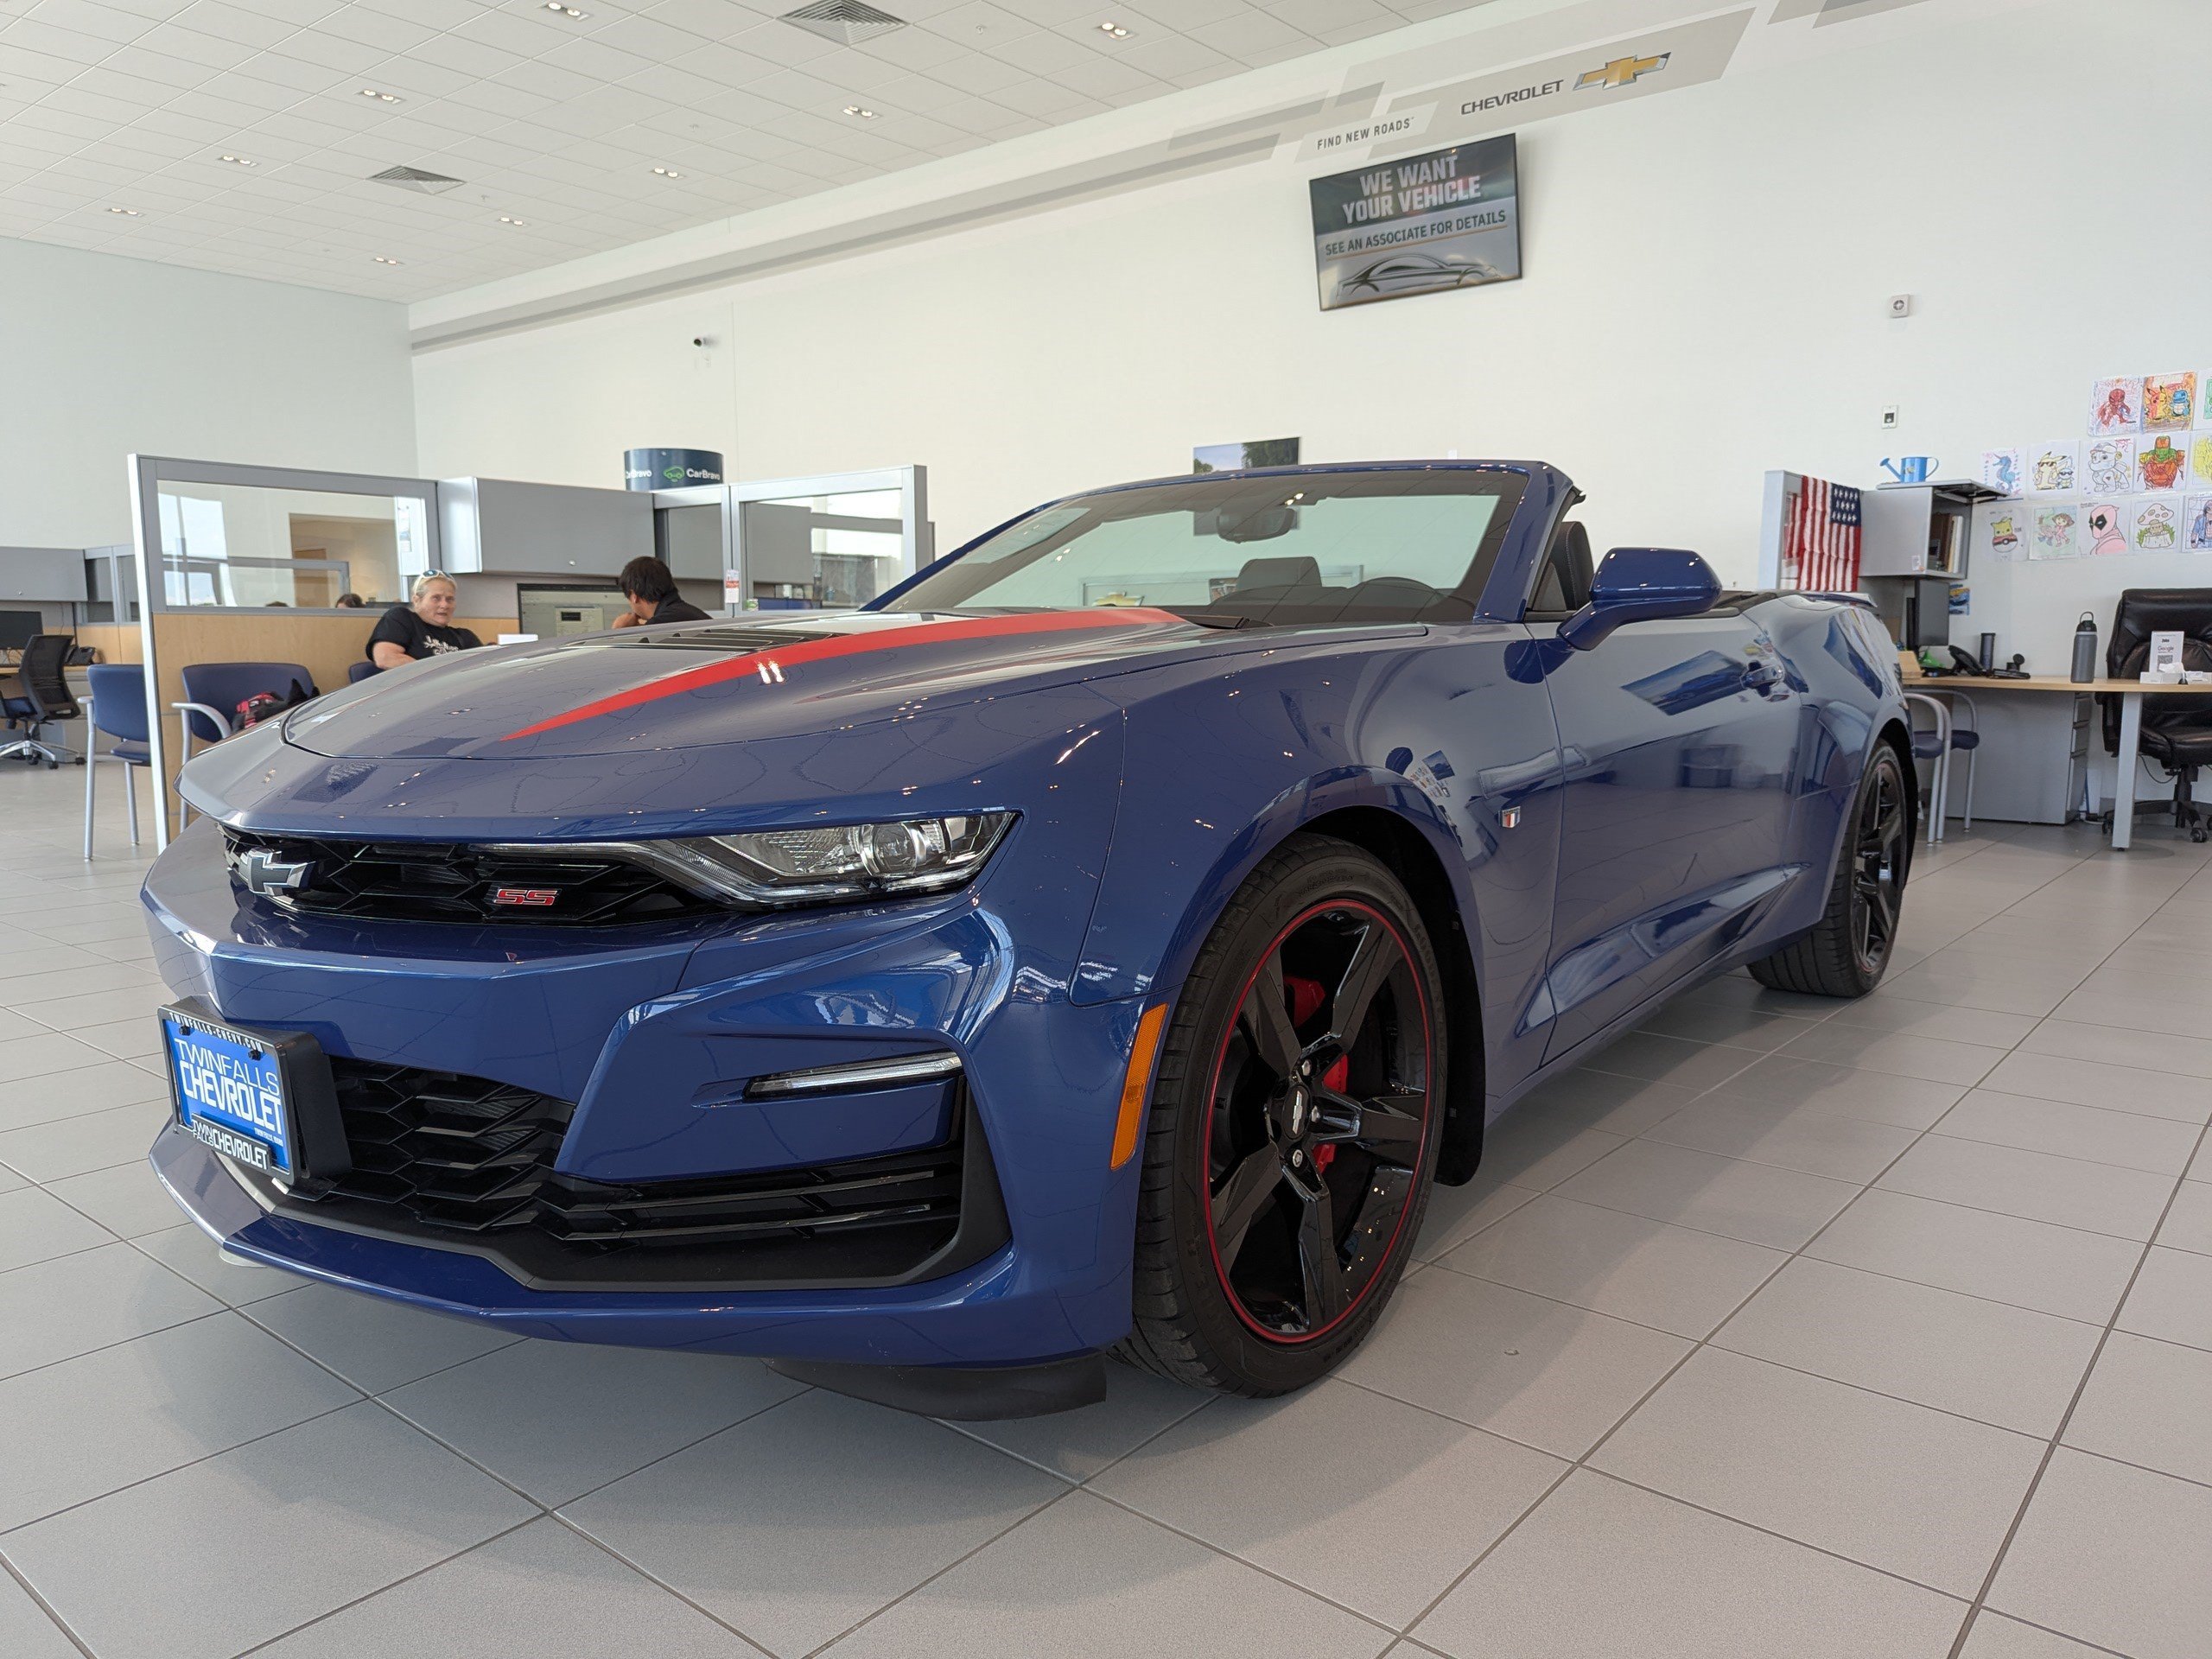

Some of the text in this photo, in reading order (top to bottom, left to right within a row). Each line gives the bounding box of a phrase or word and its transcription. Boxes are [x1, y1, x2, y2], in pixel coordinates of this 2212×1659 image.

[1460, 79, 1564, 115] CHEVROLET
[1317, 118, 1411, 150] FIND NEW ROADS
[1359, 155, 1459, 197] WE WANT
[1342, 175, 1481, 225] YOUR VEHICLE
[1325, 209, 1506, 256] SEE AN ASSOCIATE FOR DETAILS
[686, 467, 721, 480] CarBravo
[493, 888, 557, 906] SS
[180, 1059, 283, 1135] CHEVROLET
[192, 1119, 213, 1137] TWIN
[193, 1131, 214, 1147] FALLS
[213, 1129, 268, 1170] CHEVROLET
